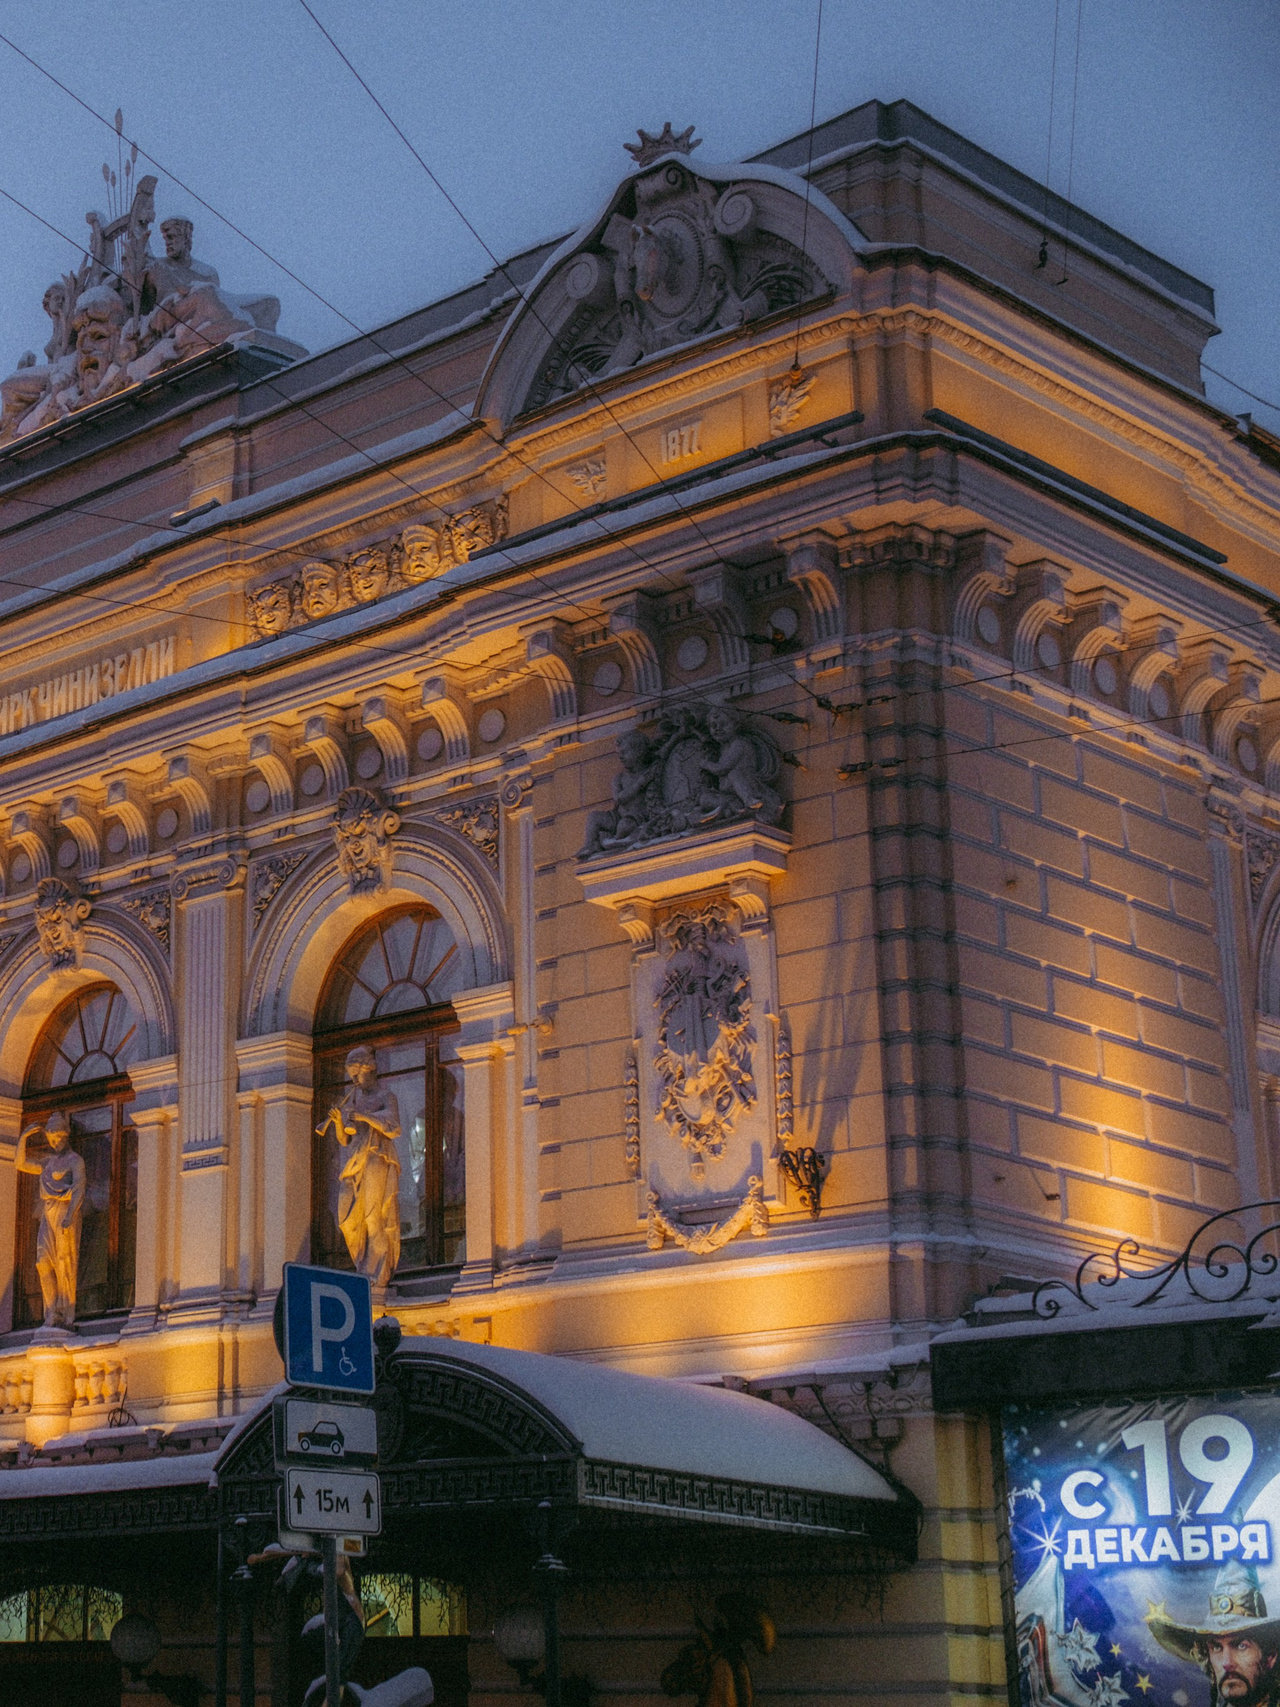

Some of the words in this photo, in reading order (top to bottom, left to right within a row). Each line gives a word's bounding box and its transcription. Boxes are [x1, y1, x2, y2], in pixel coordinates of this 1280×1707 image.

[38, 636, 177, 723] ЧИНИЗЕЛЛИ
[311, 1281, 356, 1373] P
[1121, 1414, 1254, 1516] 19
[1063, 1523, 1269, 1570] ДЕКАБРЯ
